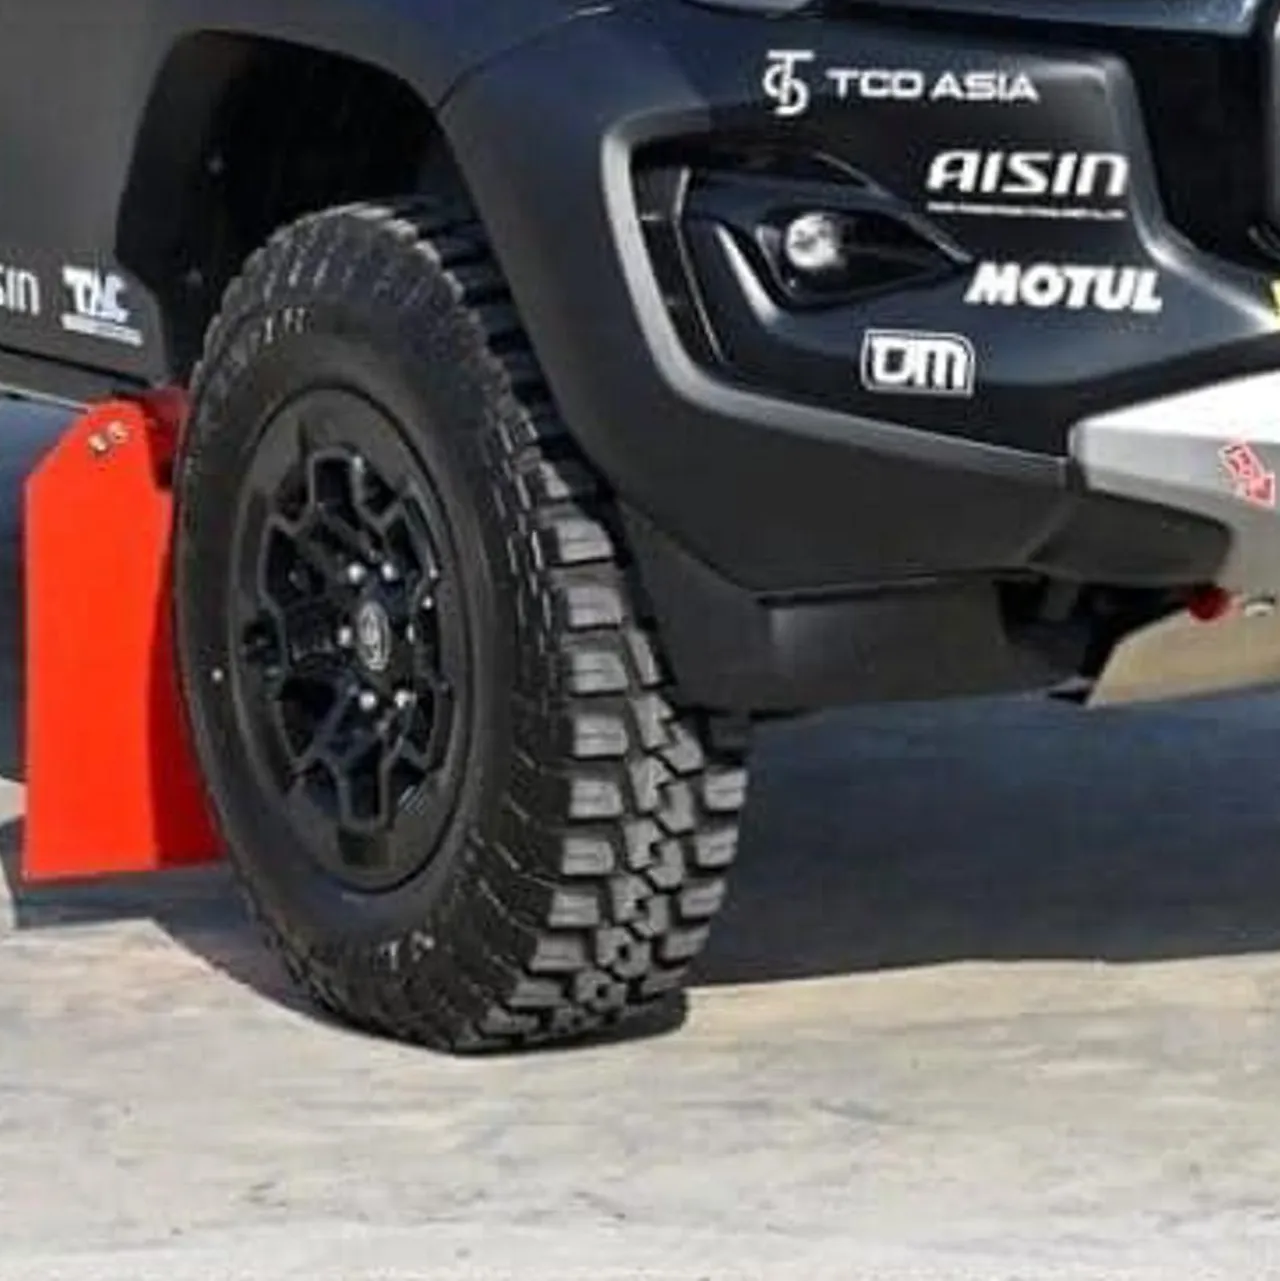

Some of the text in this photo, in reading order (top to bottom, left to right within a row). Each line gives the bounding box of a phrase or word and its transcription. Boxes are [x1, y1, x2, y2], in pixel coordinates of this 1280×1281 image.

[930, 70, 1041, 104] ASIA
[925, 150, 1130, 197] AISIN
[963, 260, 1164, 314] MOTUL
